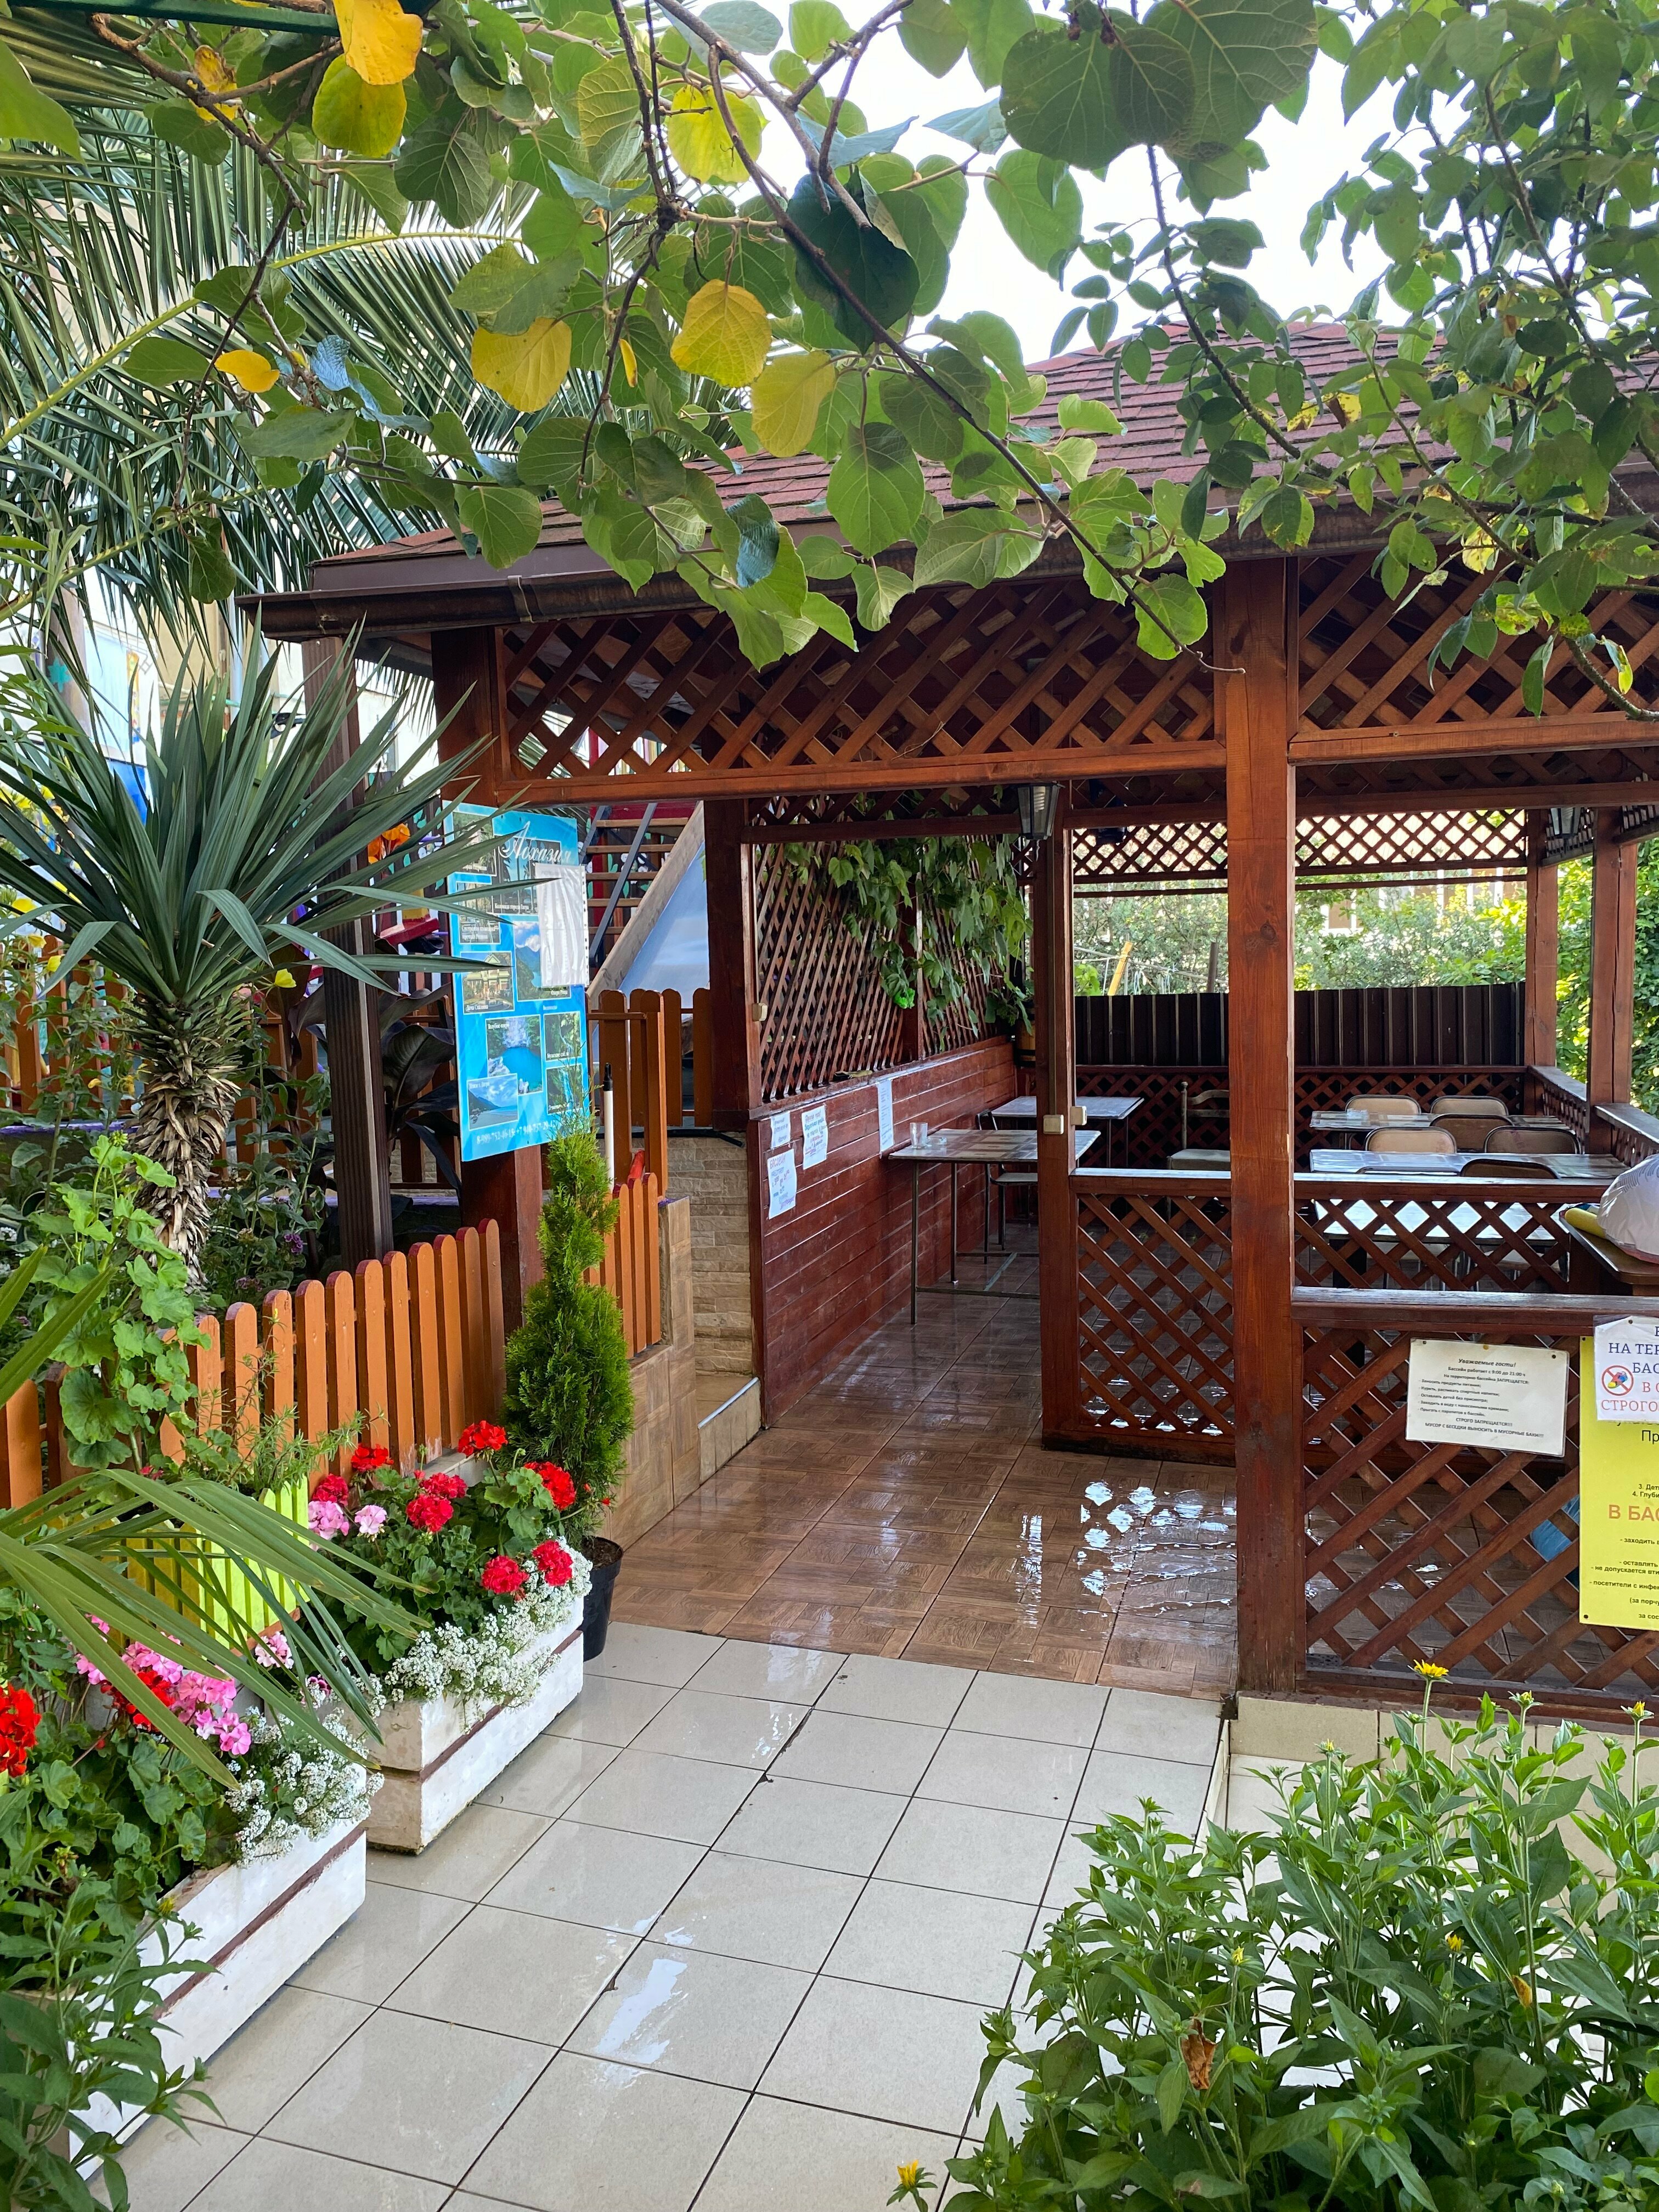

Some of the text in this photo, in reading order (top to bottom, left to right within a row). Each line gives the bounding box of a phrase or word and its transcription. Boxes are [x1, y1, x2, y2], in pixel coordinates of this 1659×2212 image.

[1609, 1343, 1631, 1353] НА
[1642, 1381, 1651, 1392] В
[1601, 1400, 1658, 1412] СТРОГО
[1609, 1504, 1621, 1519] В
[1593, 1580, 1632, 1588] посетители
